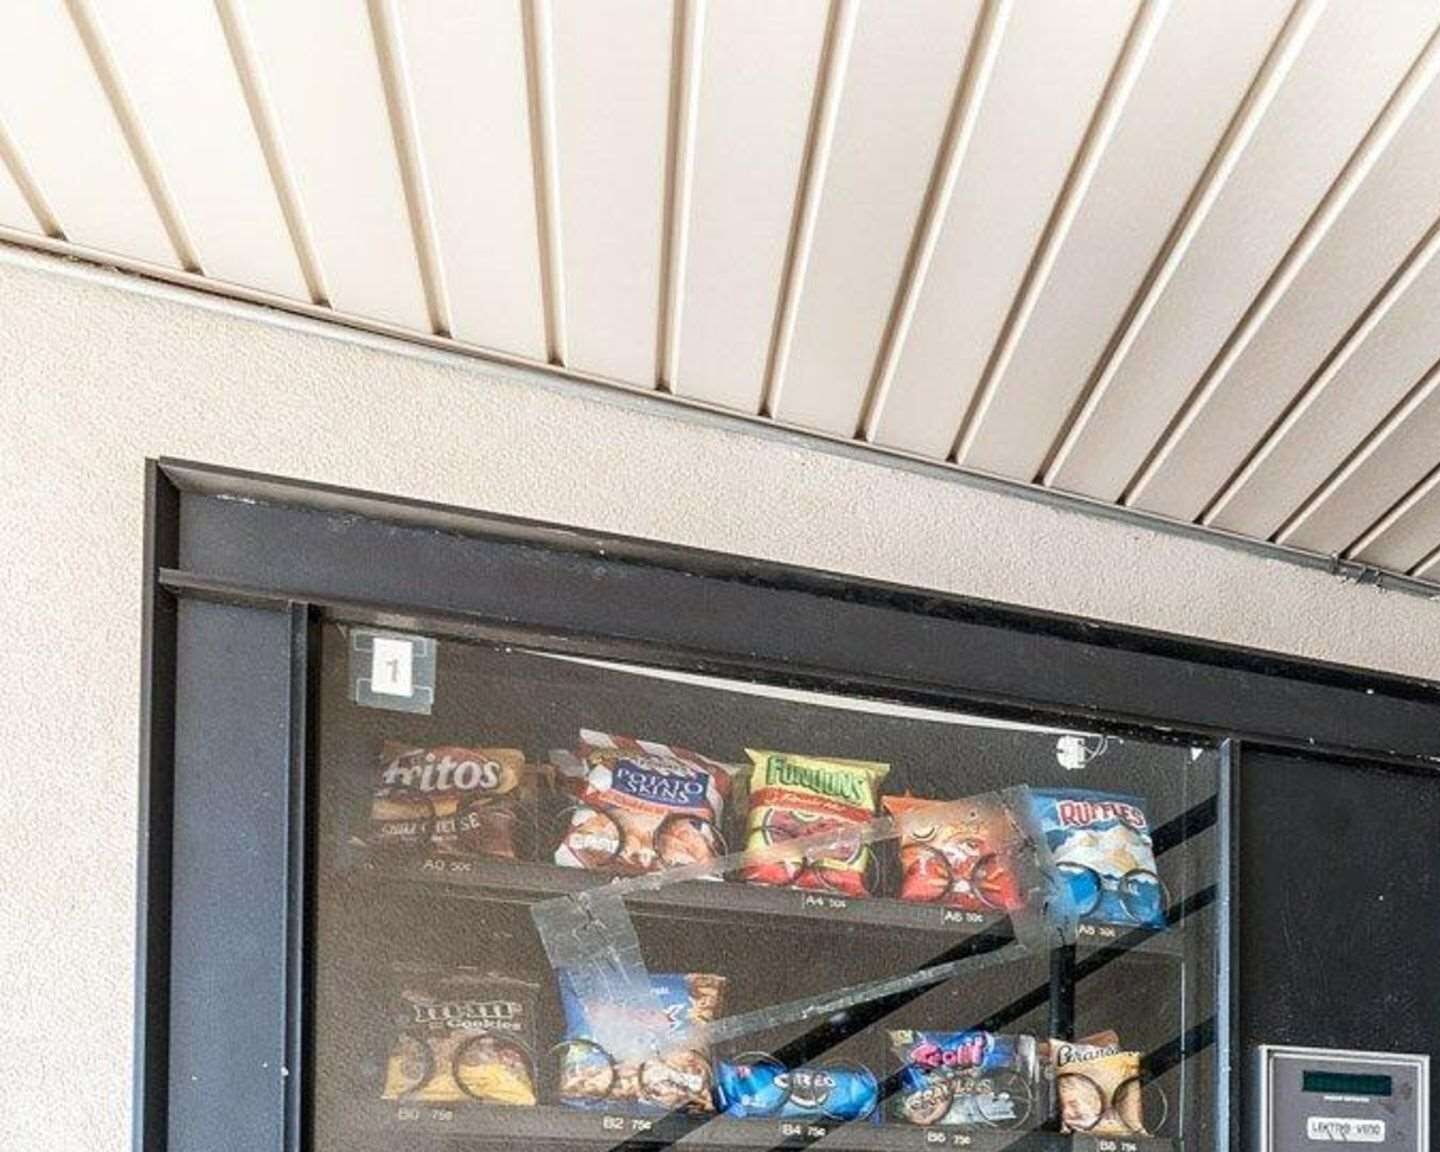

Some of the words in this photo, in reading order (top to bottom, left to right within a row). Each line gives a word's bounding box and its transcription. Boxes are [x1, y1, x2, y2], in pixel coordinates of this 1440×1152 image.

[382, 749, 501, 792] Fritos
[616, 768, 703, 794] POTATO
[627, 781, 690, 803] SKINS
[1058, 800, 1147, 829] RUFFLES
